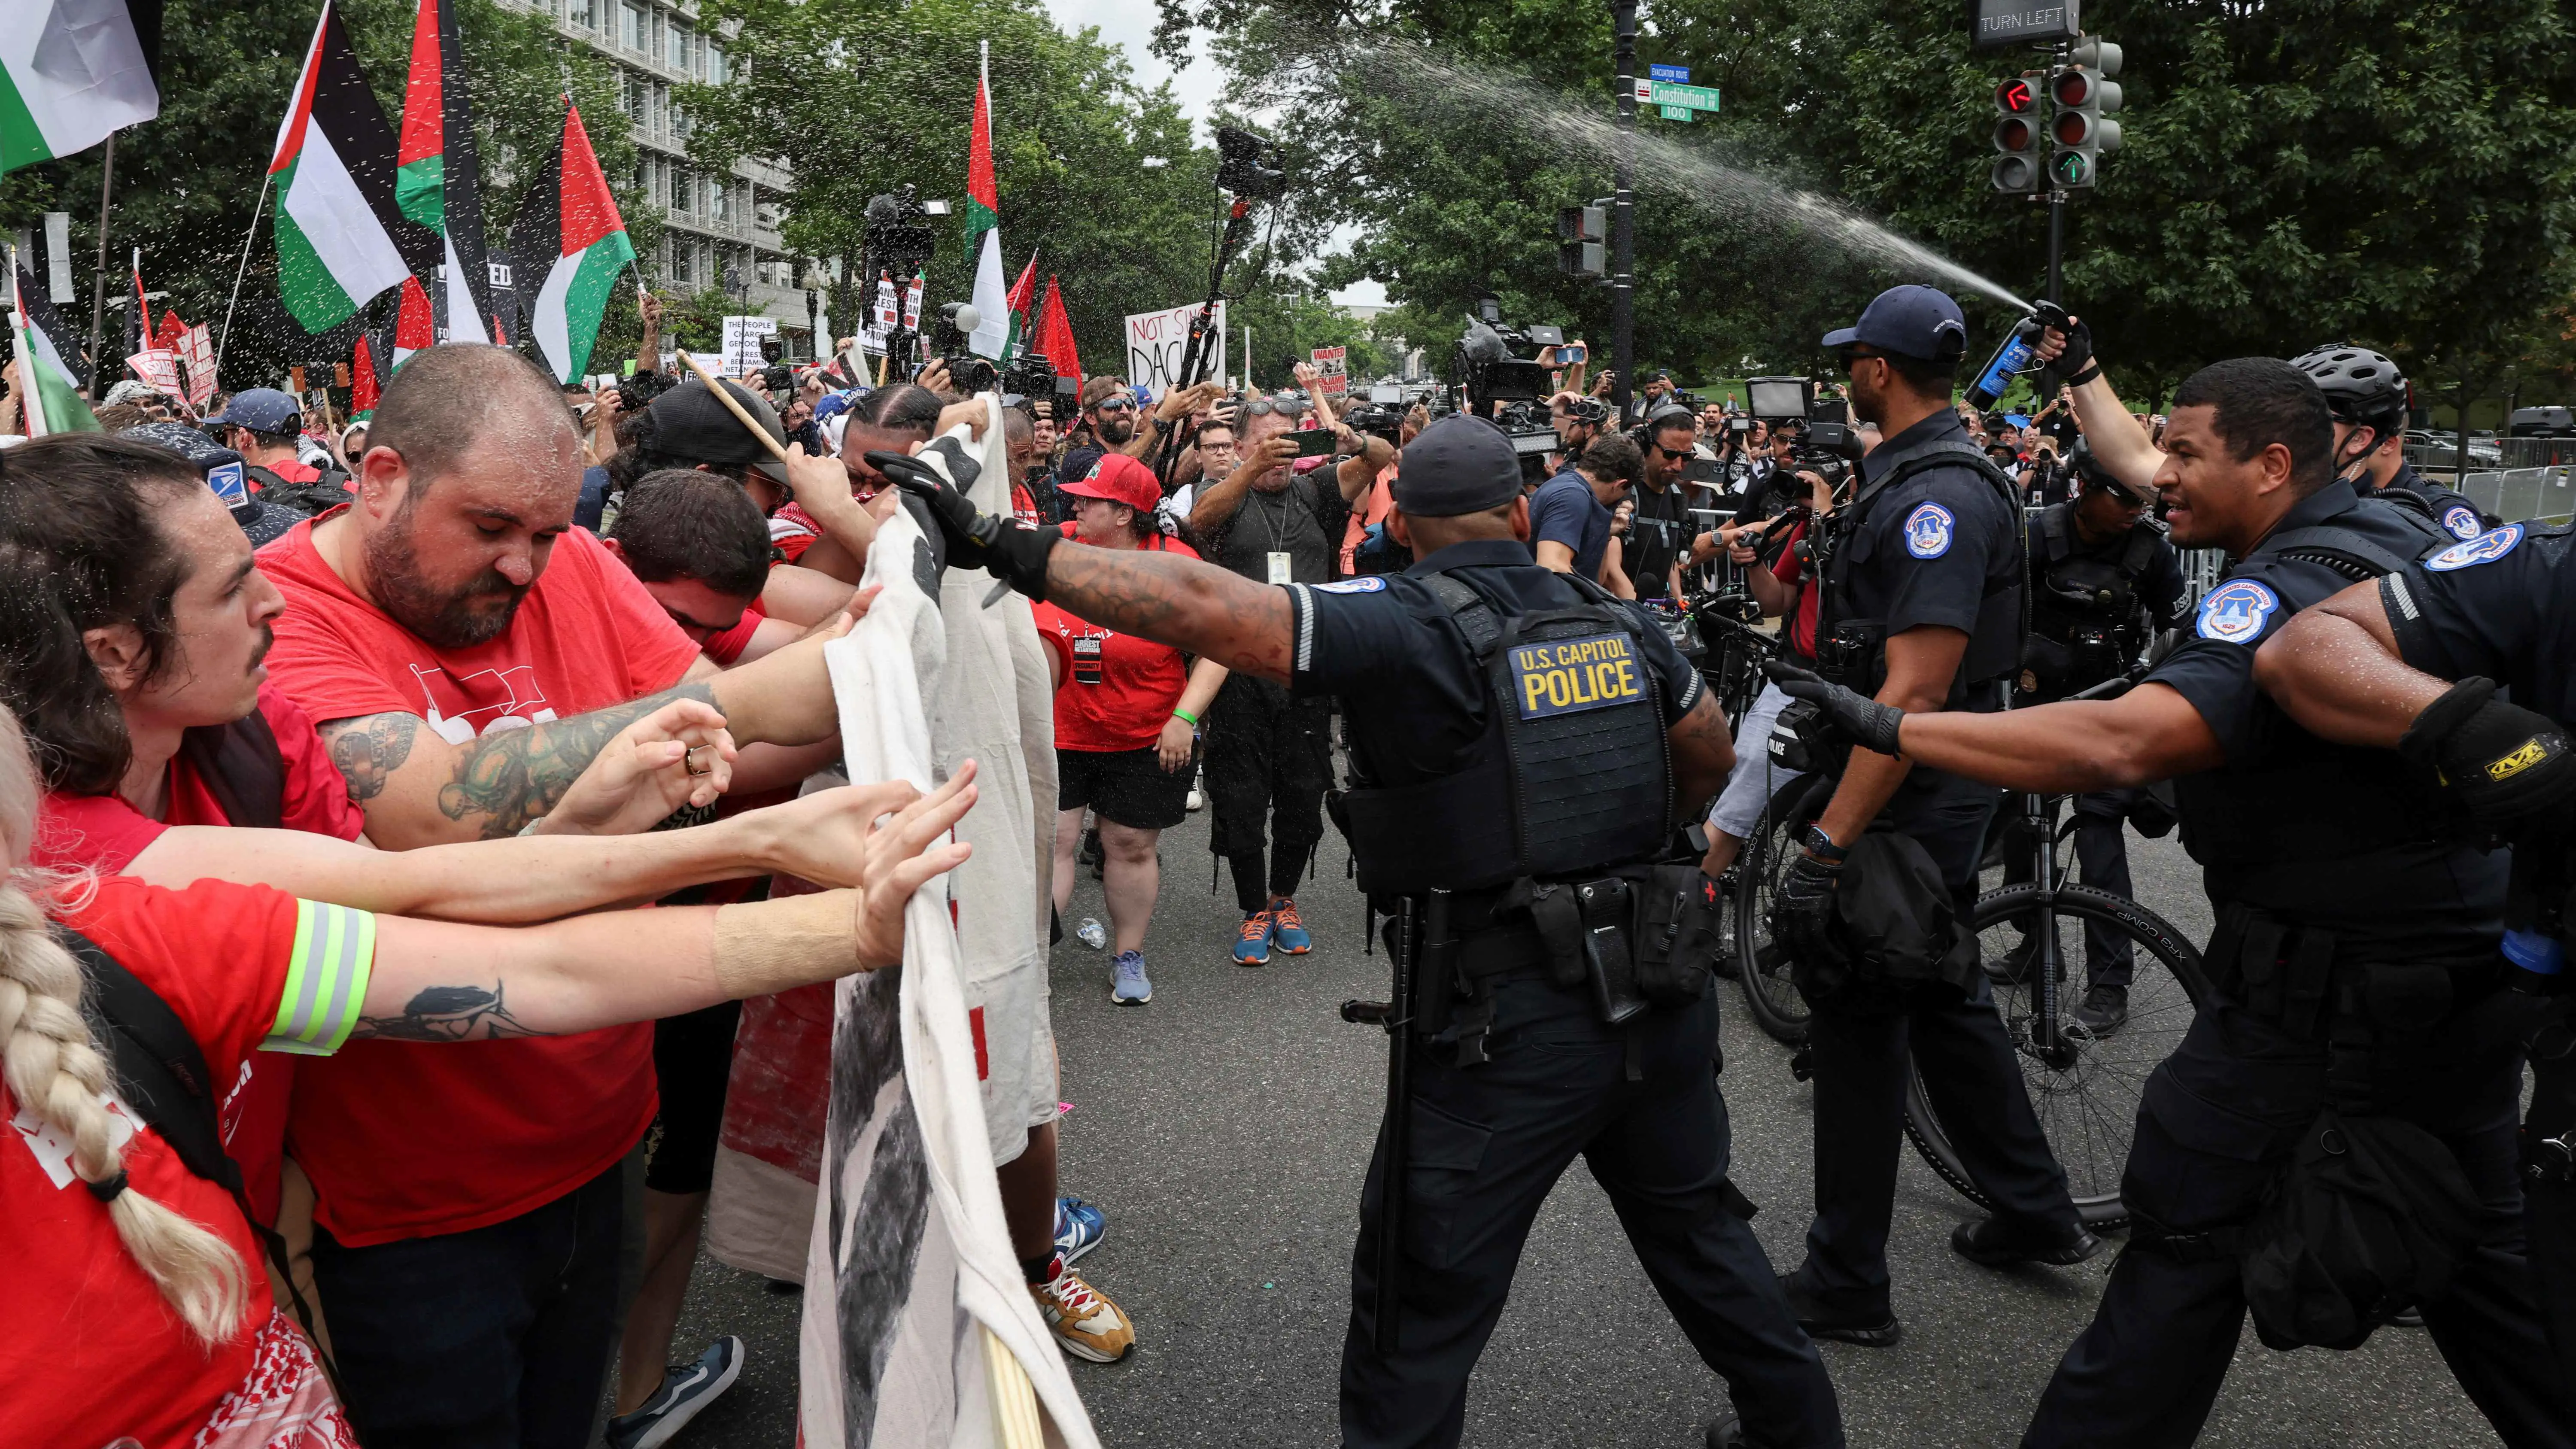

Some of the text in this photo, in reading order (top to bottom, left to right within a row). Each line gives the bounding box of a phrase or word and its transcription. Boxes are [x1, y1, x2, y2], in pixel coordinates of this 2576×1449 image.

[1981, 7, 2063, 31] TURN LEFT
[1652, 68, 1688, 79] EVACUATION ROUTE
[1653, 84, 1705, 107] Constitution
[1667, 106, 1685, 118] 100
[1708, 100, 1716, 109] NW
[437, 327, 449, 339] FO
[1133, 315, 1167, 345] NOT
[1313, 347, 1344, 360] WANTED
[1318, 374, 1346, 387] ENJAMIN
[1320, 383, 1346, 394] TANYAHU
[841, 389, 870, 406] BROOK
[2208, 584, 2270, 606] UNITED STATES CAPITOL POLICE
[1075, 639, 1100, 648] ARREST
[1519, 638, 1630, 671] U.S. CAPITOL
[1523, 659, 1639, 711] POLICE
[1768, 738, 1786, 756] POLICE
[1745, 817, 1768, 866] XR3 COMP
[2117, 912, 2187, 963] XR3 COMP
